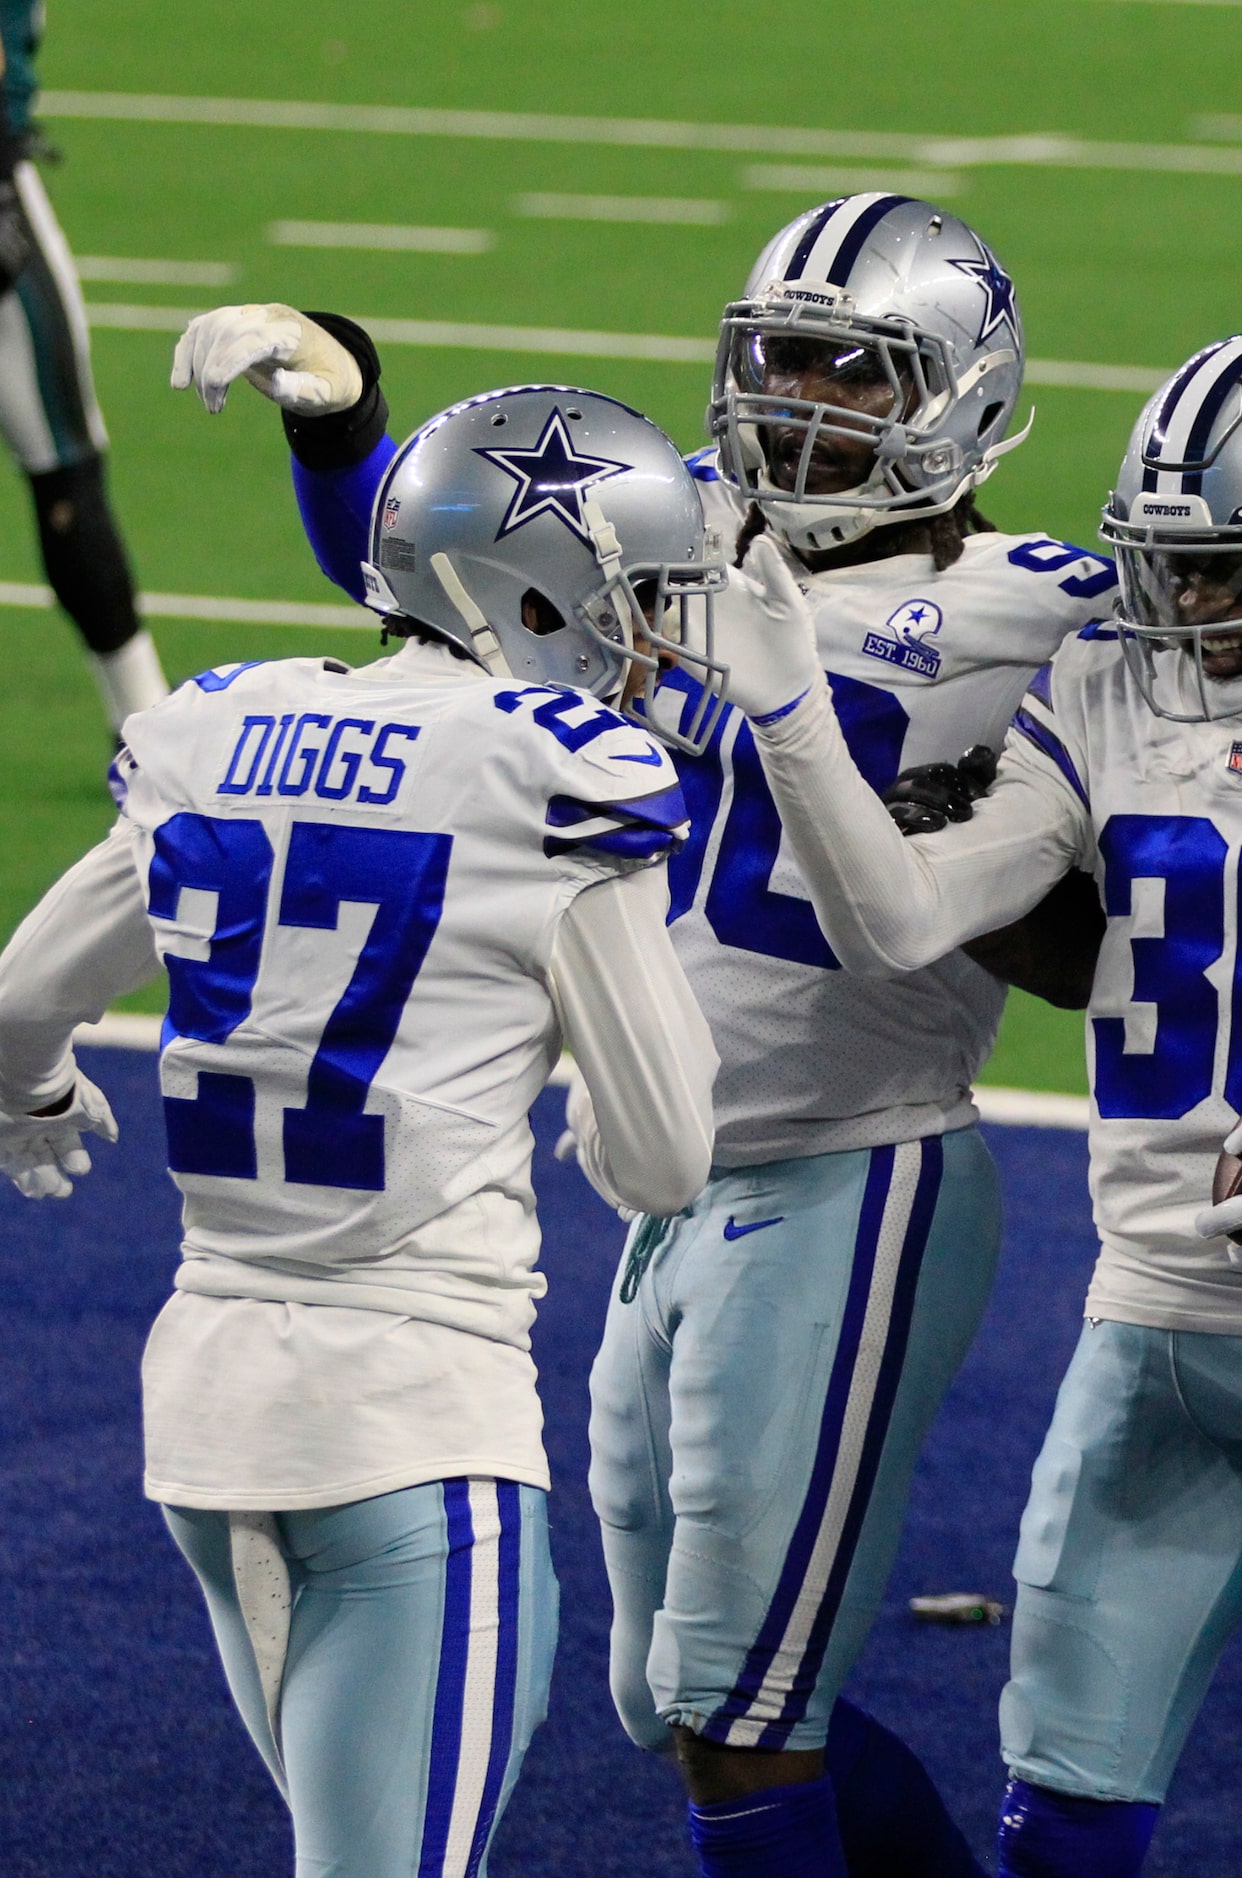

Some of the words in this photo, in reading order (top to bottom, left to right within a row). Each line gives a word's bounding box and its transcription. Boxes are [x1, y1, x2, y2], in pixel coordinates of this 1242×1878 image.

[783, 289, 835, 306] COWBOYS
[1142, 503, 1192, 517] COWBOYS
[865, 635, 897, 662] EST.
[901, 650, 938, 676] 1960
[216, 712, 422, 806] DIGGS
[147, 811, 455, 1192] 27
